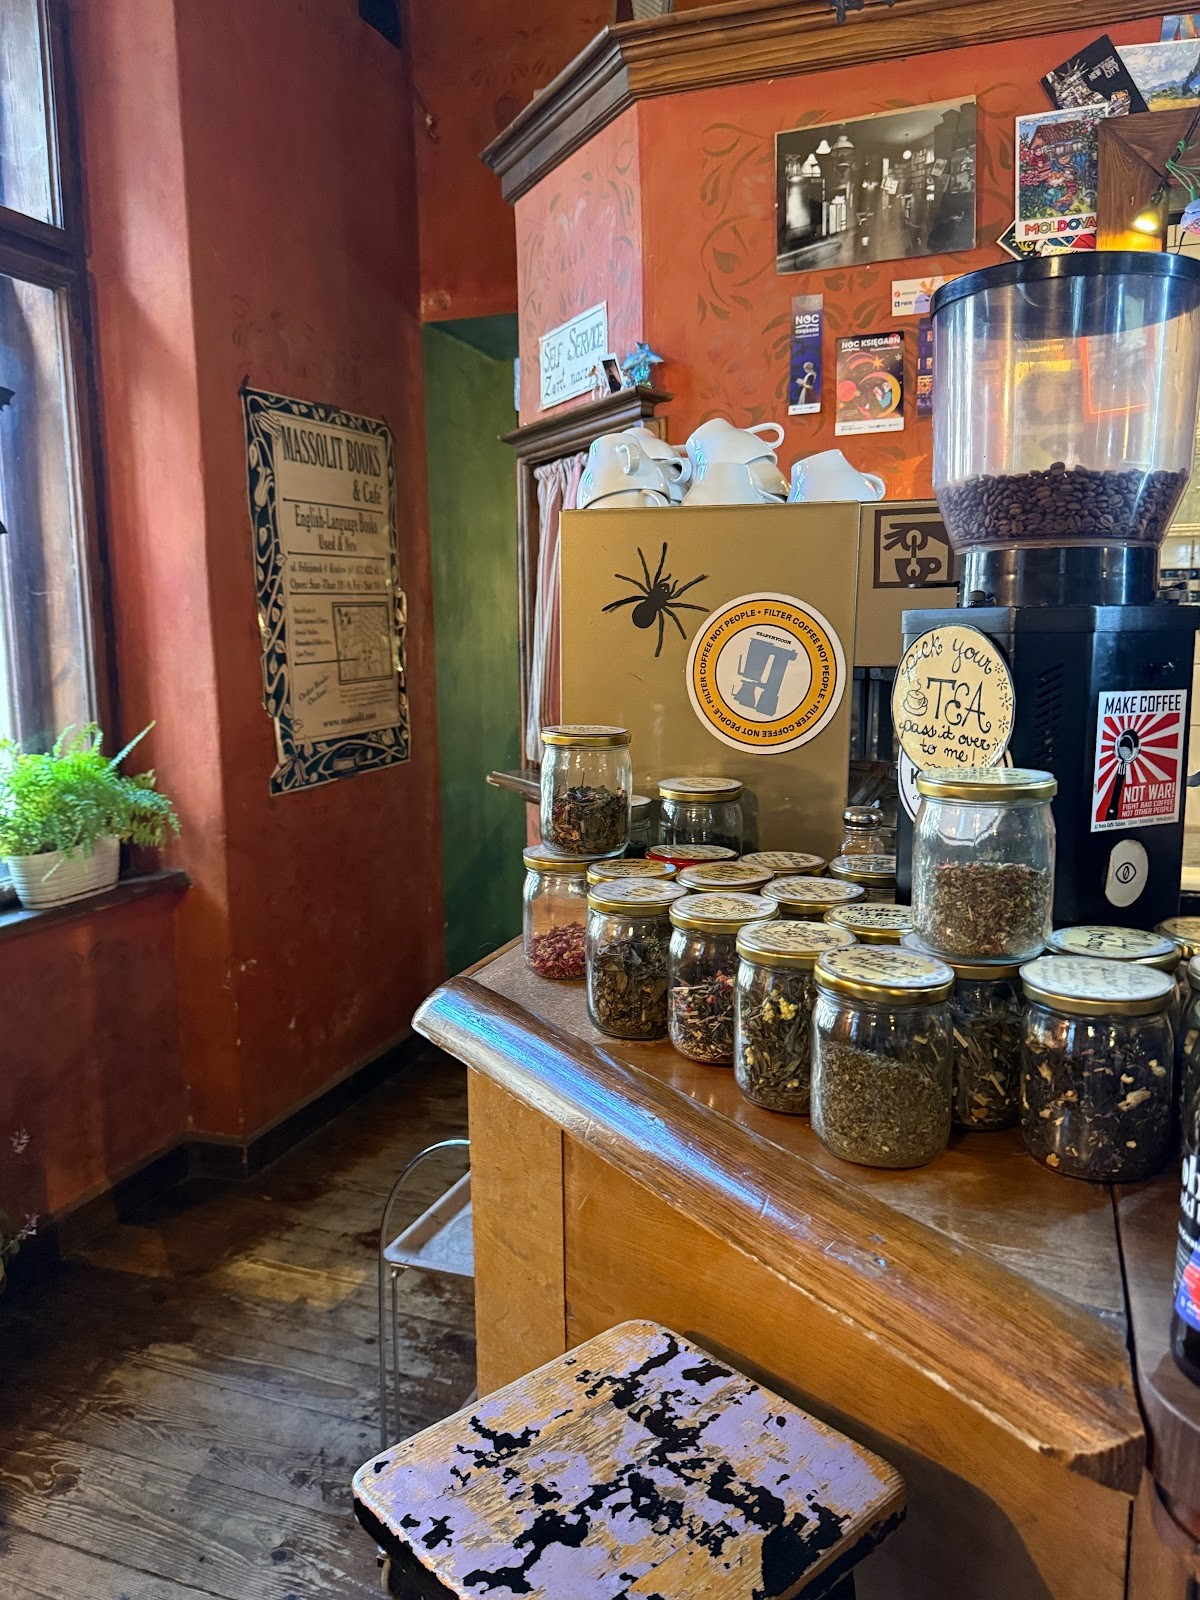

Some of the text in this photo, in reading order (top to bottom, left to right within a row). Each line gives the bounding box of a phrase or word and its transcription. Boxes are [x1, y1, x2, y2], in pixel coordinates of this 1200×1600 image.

[1025, 216, 1097, 236] MOLDOVA
[795, 314, 819, 325] NOC
[544, 321, 604, 373] SELF SERVICE
[842, 340, 860, 349] NOC
[281, 425, 382, 477] MASSOLIT BOOKS
[353, 480, 384, 505] & Café
[319, 534, 336, 551] Used
[700, 609, 756, 704] FILTER COFFEE NOT PEOPLE
[764, 608, 830, 700] FILTER COFFEE NOT PEOPLE
[901, 633, 992, 684] pick your
[926, 676, 992, 734] TEA
[1104, 695, 1181, 714] MAKE COFFEE
[713, 704, 819, 738] FILTER COFFEE NOT PEOPLE
[899, 719, 991, 751] pass it over
[919, 738, 937, 755] to
[1123, 783, 1175, 803] NOT WAR!
[1153, 799, 1174, 807] COFFEE
[1121, 806, 1173, 818] NOT OTHER PEOPLE
